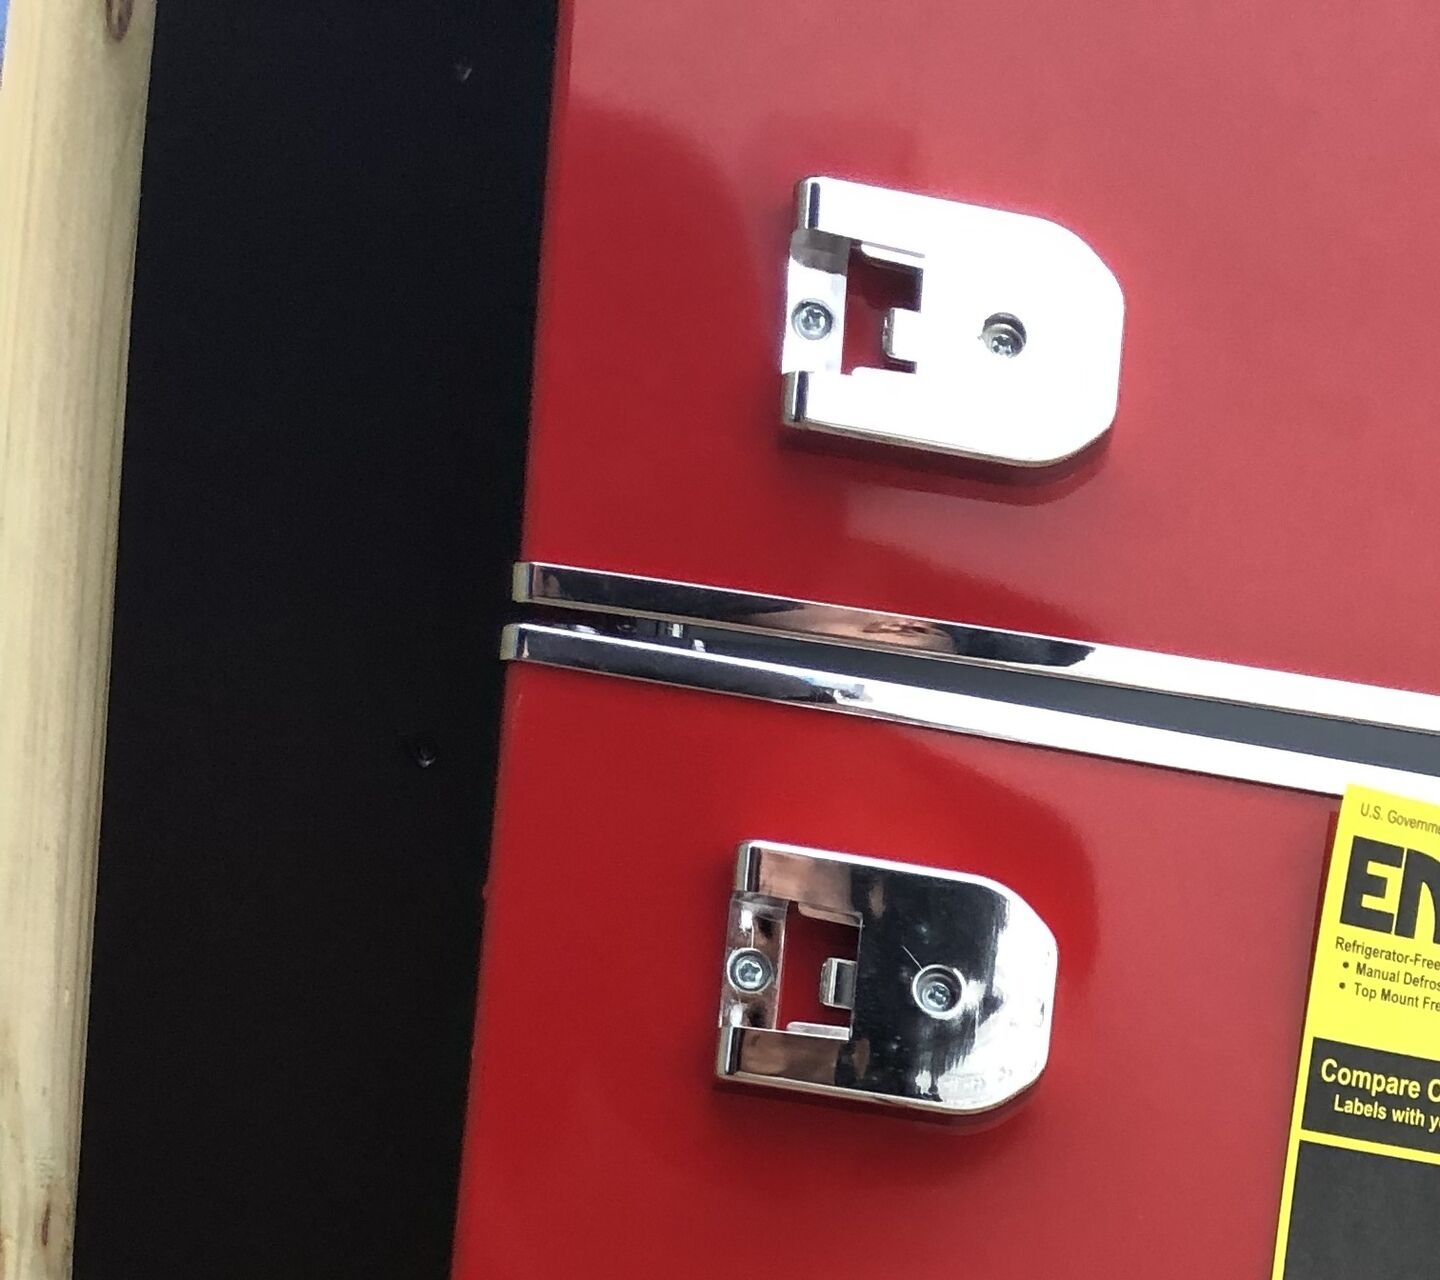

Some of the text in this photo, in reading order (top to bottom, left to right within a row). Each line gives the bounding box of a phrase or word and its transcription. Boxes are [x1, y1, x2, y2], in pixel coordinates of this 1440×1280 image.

[1360, 802, 1384, 821] U.S.
[1355, 961, 1400, 982] Manual
[1354, 981, 1376, 1001] Top
[1380, 987, 1419, 1007] Mount
[1321, 1058, 1420, 1098] Compare
[1333, 1093, 1386, 1119] Labels
[1391, 1107, 1424, 1126] with
